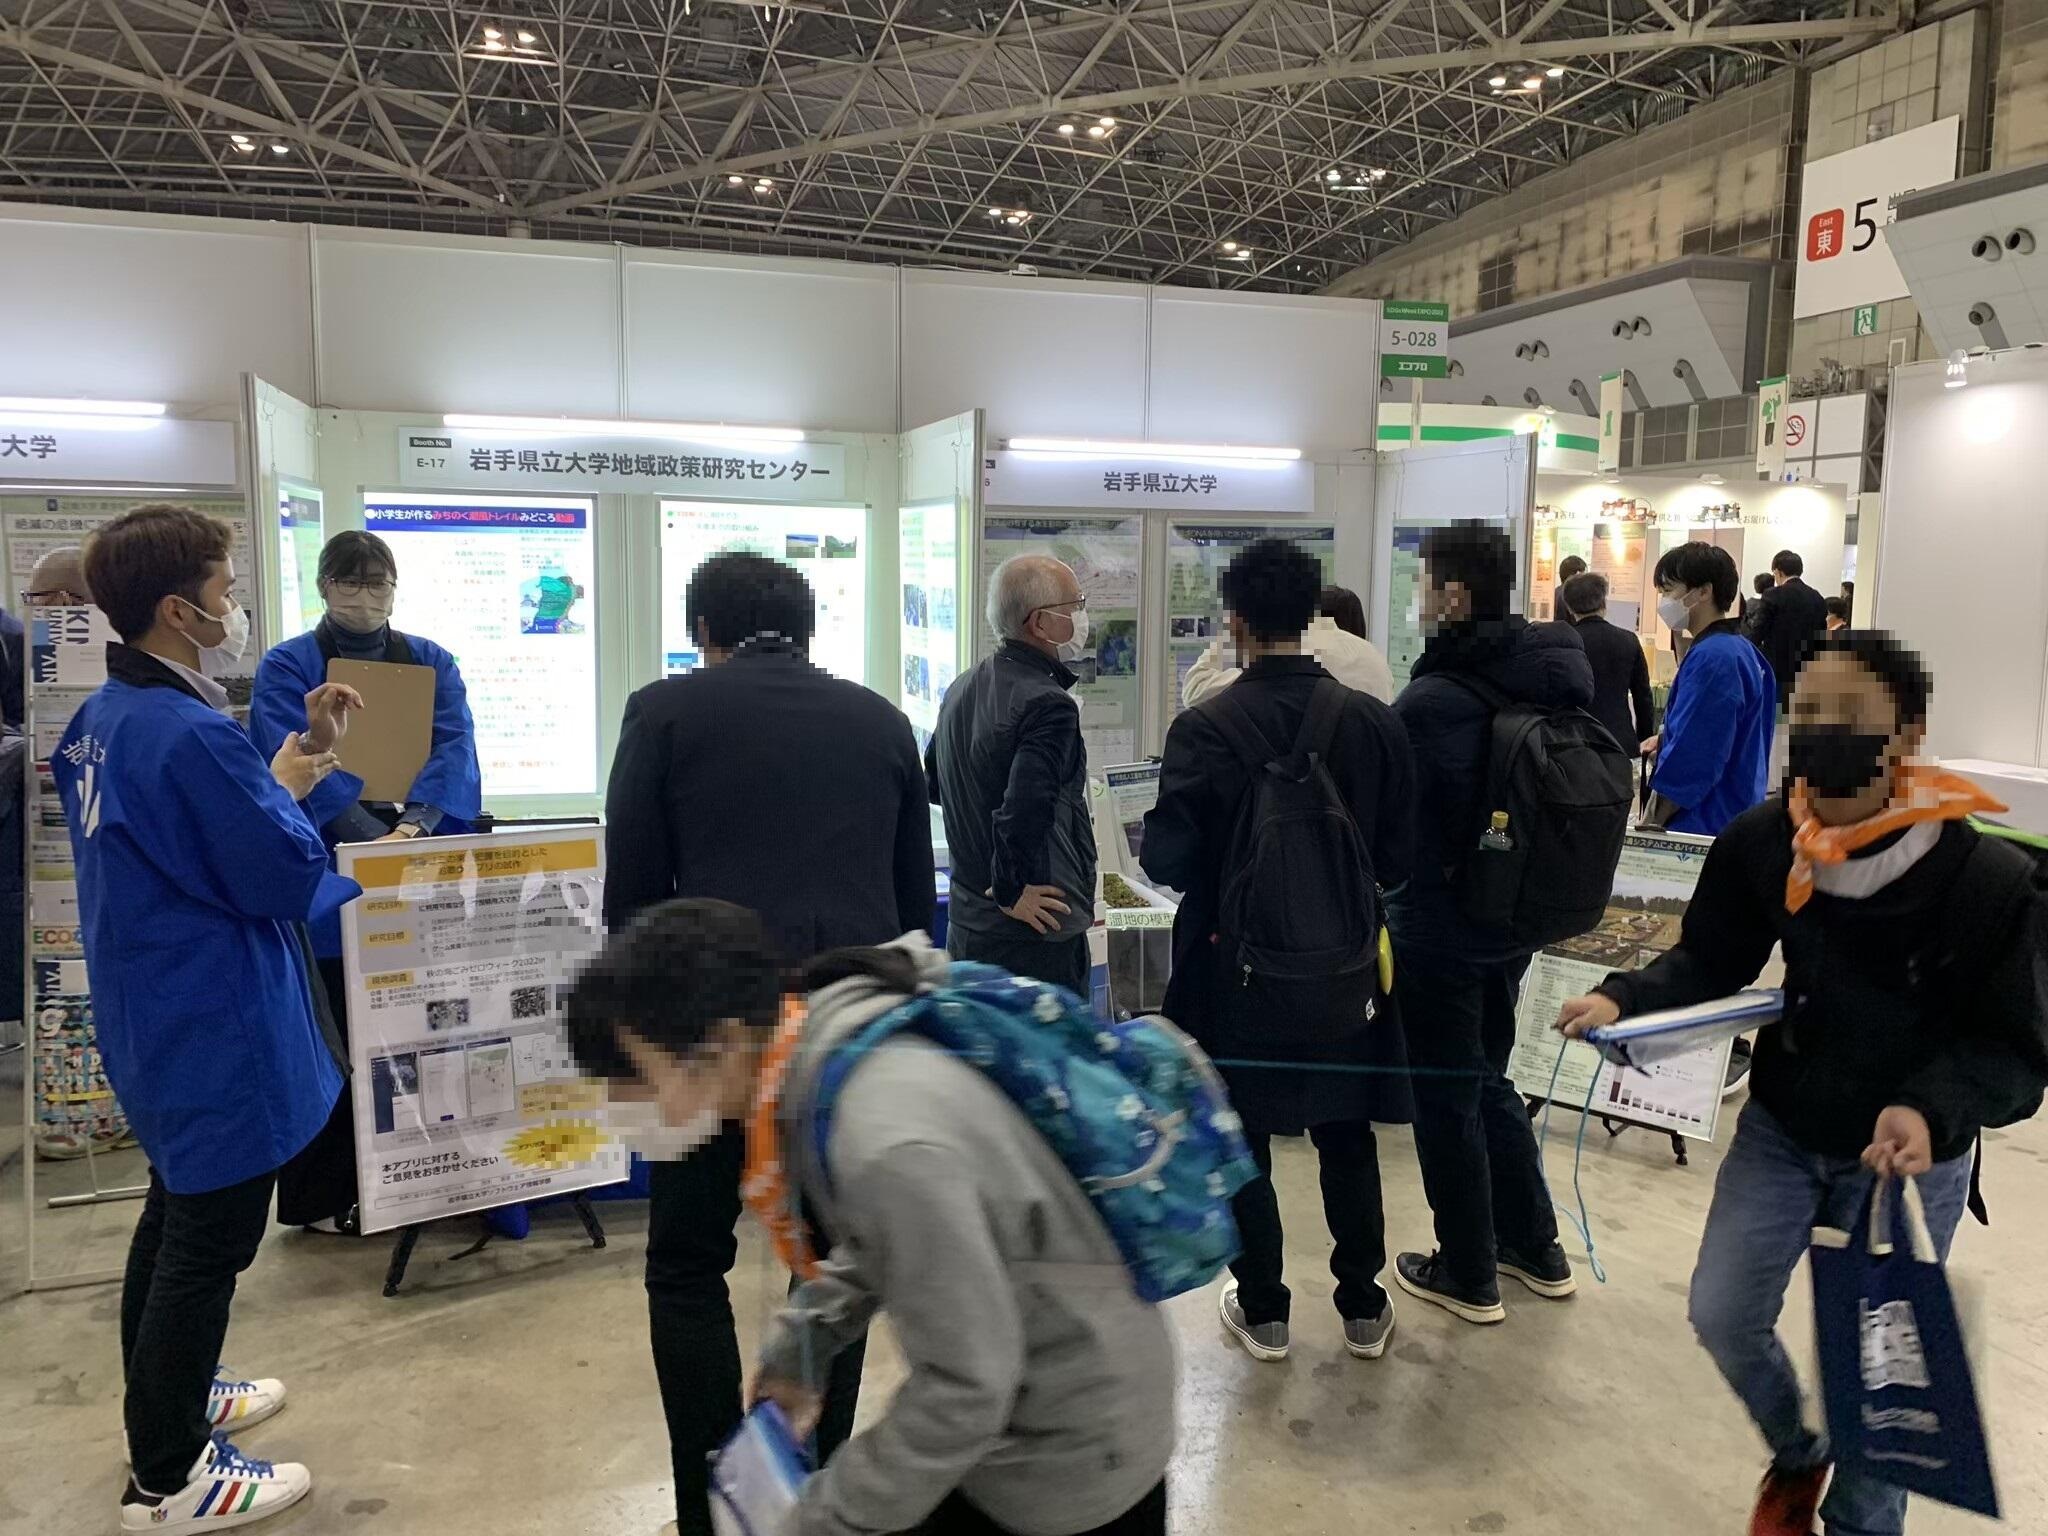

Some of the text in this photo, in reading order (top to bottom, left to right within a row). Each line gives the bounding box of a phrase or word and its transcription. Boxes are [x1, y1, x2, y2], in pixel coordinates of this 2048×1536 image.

[1818, 216, 1834, 228] East
[1852, 197, 1878, 252] 5
[1816, 229, 1834, 255] 東
[1391, 330, 1437, 347] 5-028
[1398, 361, 1428, 371] エコプロ
[1, 434, 57, 459] 大学
[416, 458, 446, 469] E-17
[469, 448, 831, 481] 岩手県立大学地域政策研究センター
[1103, 471, 1218, 494] 岩手県立大学
[381, 1151, 460, 1173] 本アプリに対する
